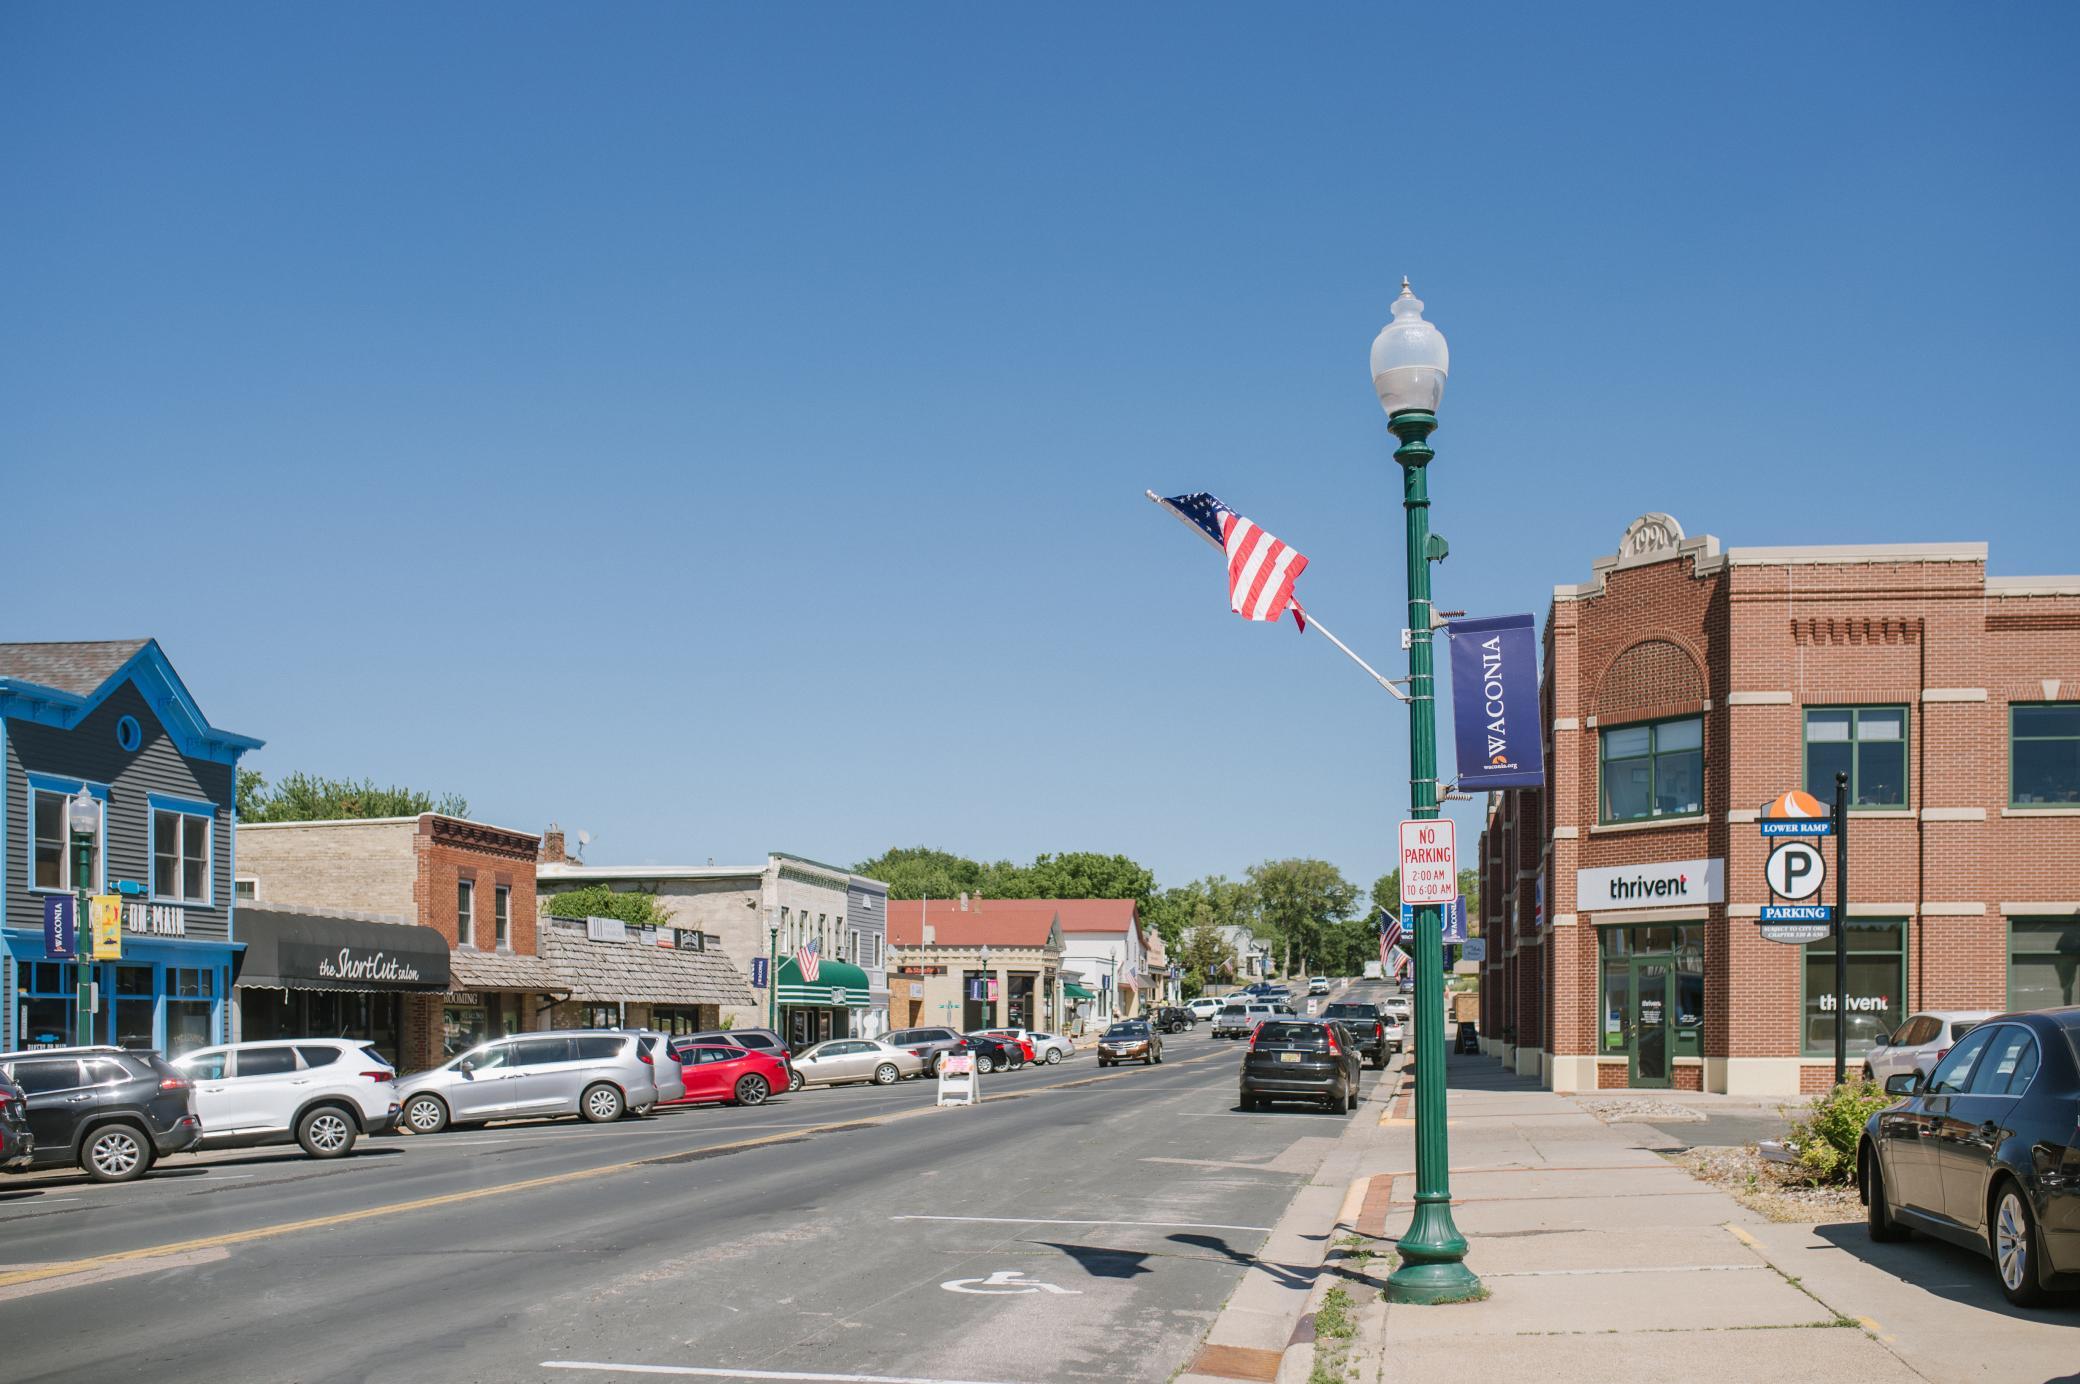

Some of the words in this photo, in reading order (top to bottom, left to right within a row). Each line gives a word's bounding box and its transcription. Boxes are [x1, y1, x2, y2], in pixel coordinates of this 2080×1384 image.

[1482, 635, 1507, 758] WACONIA
[1483, 762, 1518, 770] waconia.org
[1419, 829, 1435, 844] NO
[1764, 824, 1798, 833] LOWER
[1800, 824, 1828, 832] RAMP
[1405, 847, 1451, 864] PARKING
[1412, 870, 1431, 881] 2:00
[1433, 870, 1445, 881] AM
[1785, 851, 1812, 893] P
[1407, 885, 1416, 896] TO
[1419, 884, 1437, 895] 6:00
[1440, 884, 1451, 894] AM
[1610, 874, 1687, 899] thrivent
[129, 904, 147, 934] ON
[152, 905, 185, 936] MAIN
[1450, 903, 1458, 935] WACONI
[1766, 907, 1826, 918] PARKING
[54, 903, 63, 947] WACONIA
[319, 958, 336, 976] the
[397, 963, 420, 981] salon
[443, 992, 478, 1005] ROOMING
[1820, 993, 1889, 1011] thivent
